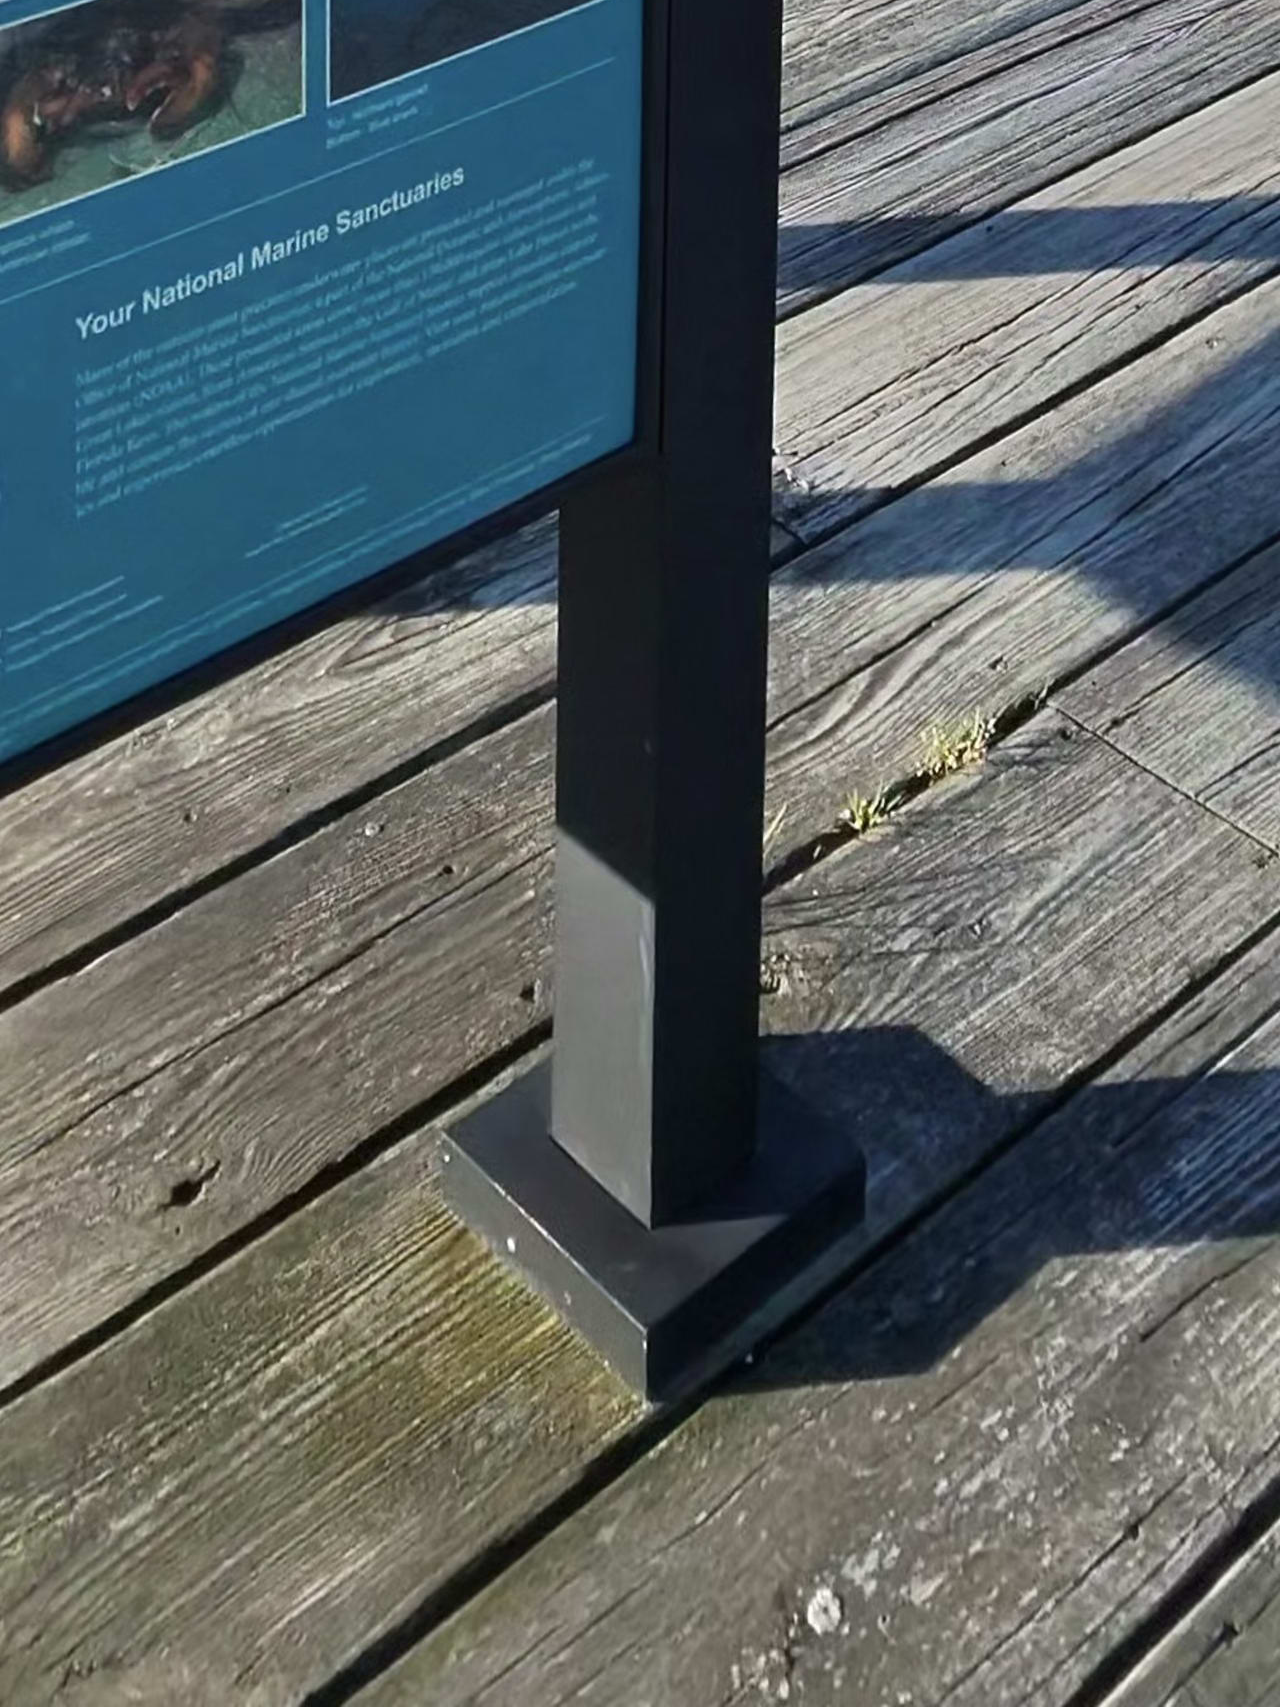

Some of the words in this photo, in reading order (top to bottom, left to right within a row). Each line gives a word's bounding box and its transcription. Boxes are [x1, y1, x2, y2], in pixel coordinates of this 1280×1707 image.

[76, 301, 135, 339] Your
[143, 253, 243, 313] National
[251, 224, 329, 270] Marine
[336, 168, 464, 234] Sanctuaries
